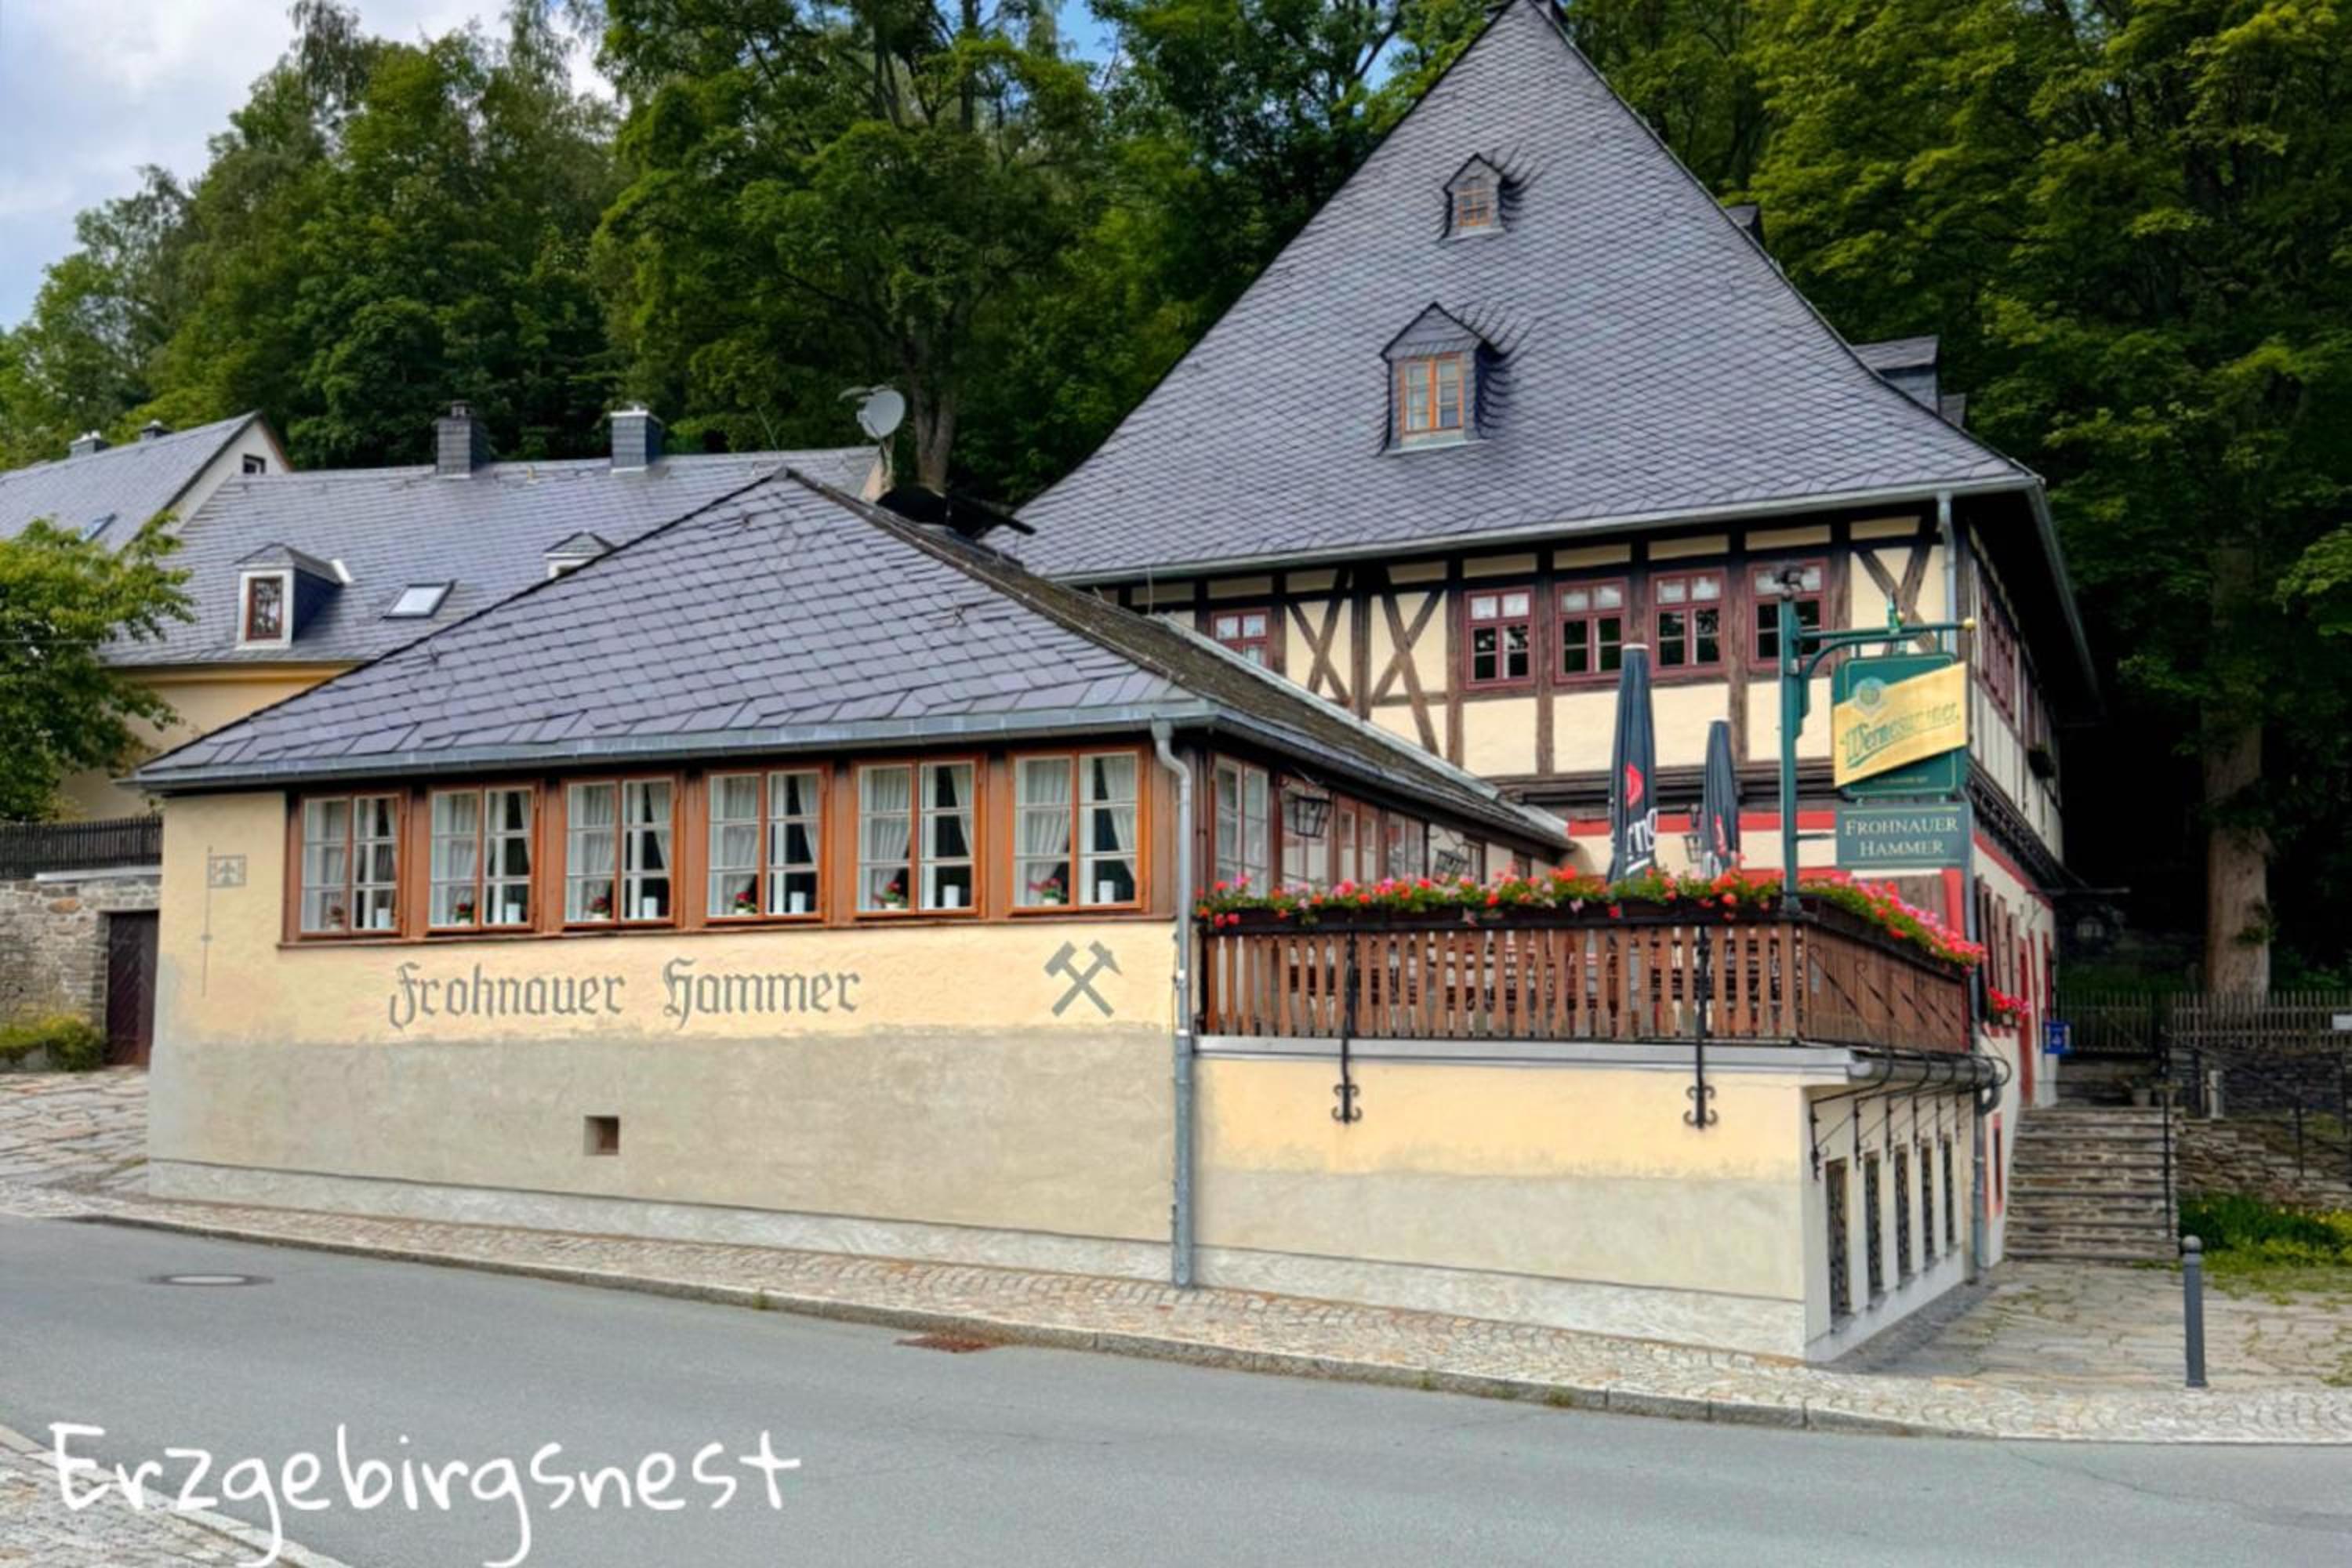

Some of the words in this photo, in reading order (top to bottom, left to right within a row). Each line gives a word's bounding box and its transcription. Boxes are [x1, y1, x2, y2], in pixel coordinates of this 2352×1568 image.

[1845, 816, 1958, 837] FROHNAUER
[1860, 840, 1944, 858] HAMMER
[389, 961, 626, 1030] Frohnauer
[662, 957, 861, 1029] Hammer
